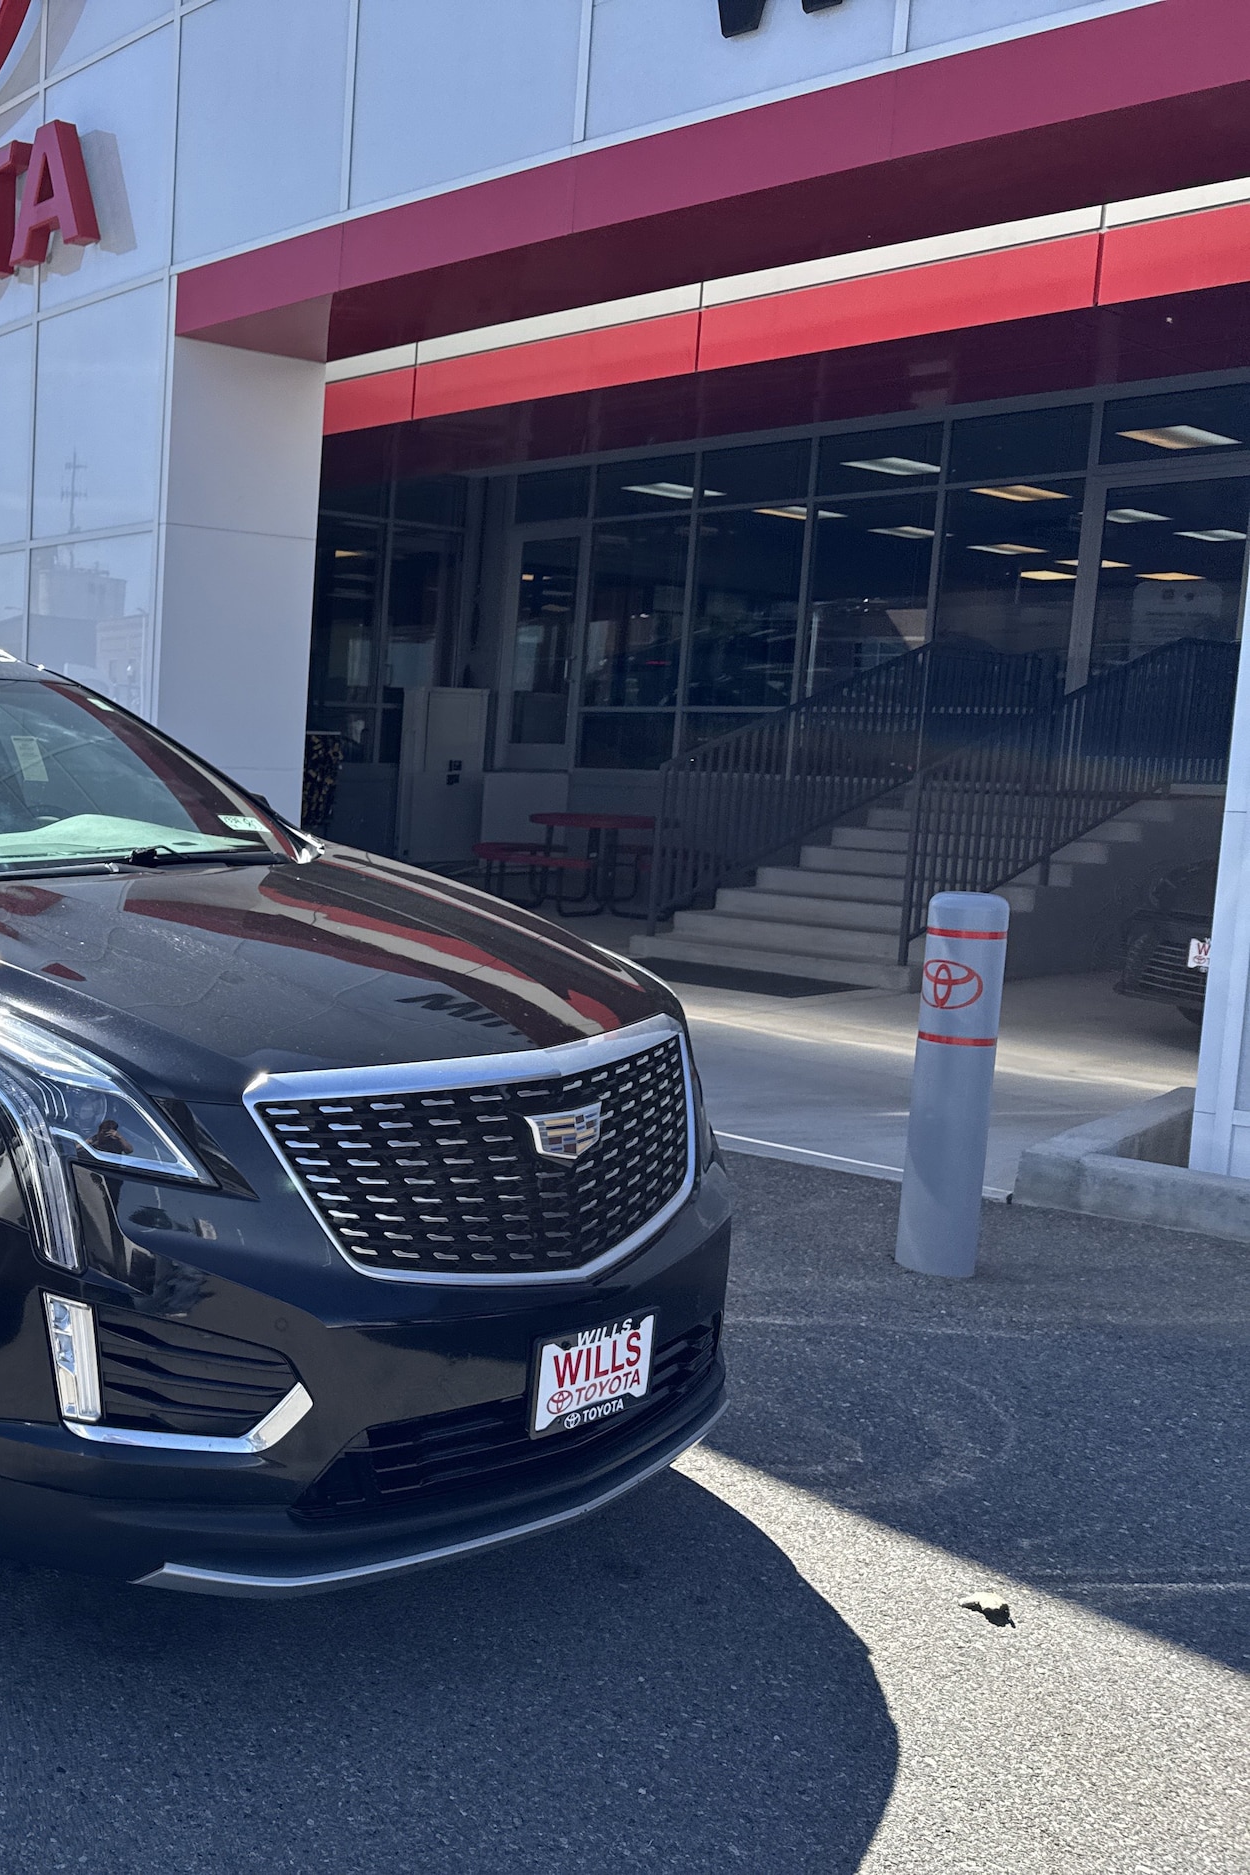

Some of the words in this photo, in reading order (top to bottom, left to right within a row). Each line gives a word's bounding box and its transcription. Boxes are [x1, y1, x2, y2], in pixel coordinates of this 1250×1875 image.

[577, 1317, 633, 1347] WILLS
[553, 1331, 641, 1389] WILLS
[575, 1368, 641, 1406] TOYOTA
[582, 1398, 624, 1423] TOYOTA
